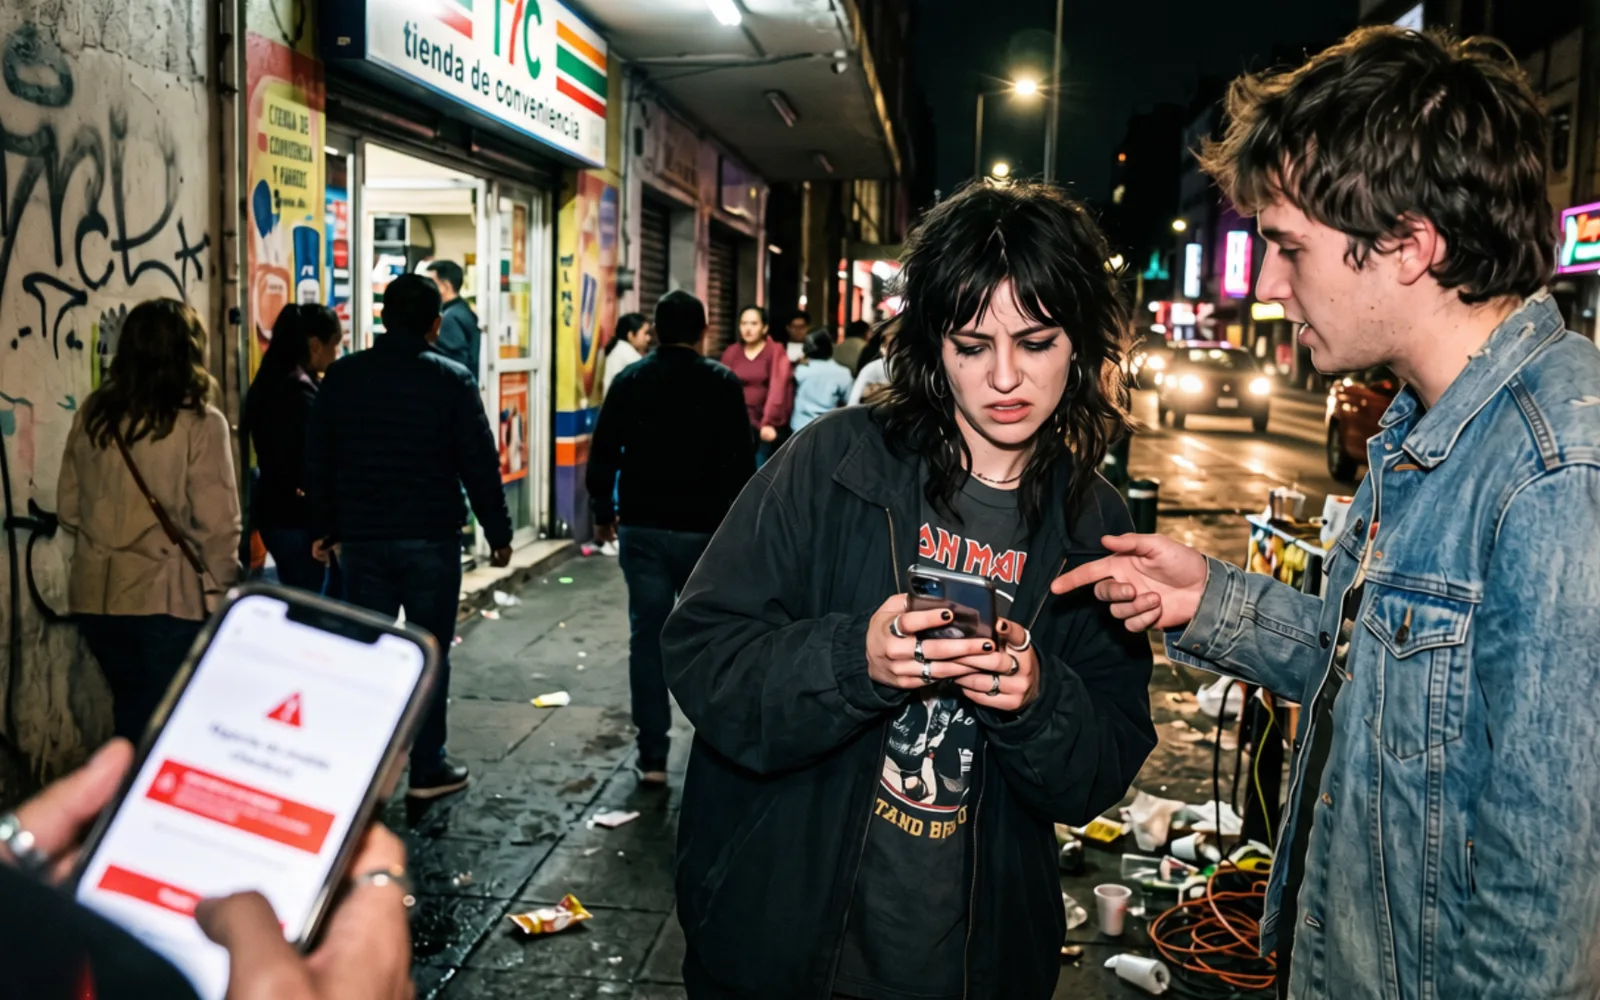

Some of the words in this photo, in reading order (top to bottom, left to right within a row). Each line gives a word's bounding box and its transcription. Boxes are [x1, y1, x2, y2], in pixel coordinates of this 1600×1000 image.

[403, 20, 464, 84] tienda
[471, 59, 489, 96] de
[496, 79, 580, 140] conveniencia
[874, 797, 924, 837] TAND
